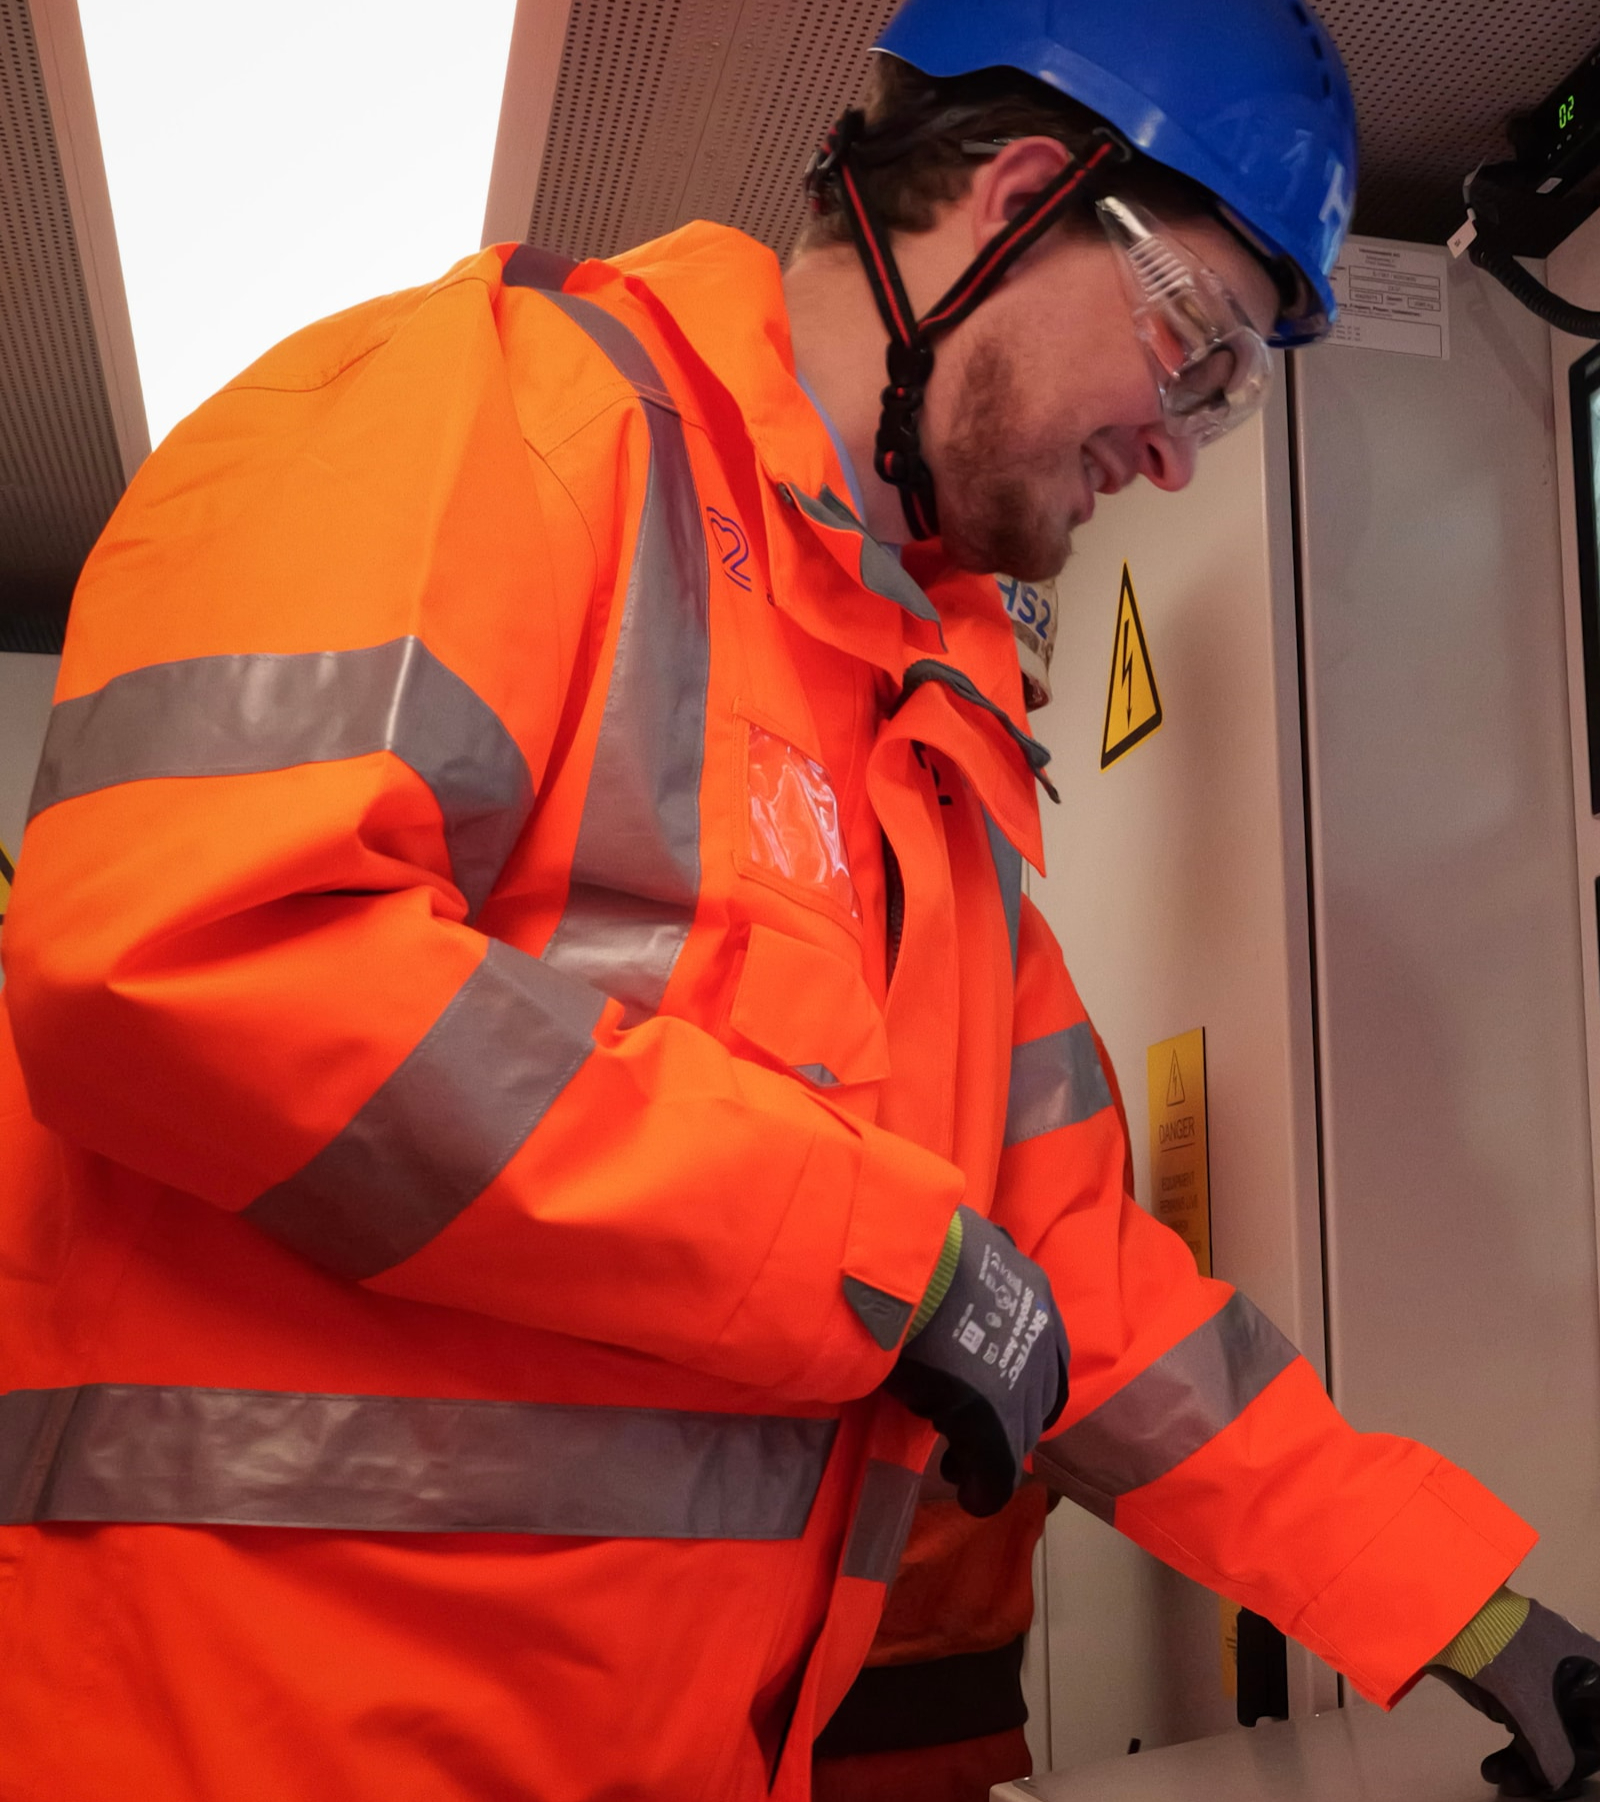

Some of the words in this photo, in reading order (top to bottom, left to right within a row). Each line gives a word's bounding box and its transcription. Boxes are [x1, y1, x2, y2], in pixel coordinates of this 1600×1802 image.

[1559, 95, 1575, 129] 02
[1158, 1116, 1195, 1145] DANGER
[1009, 1309, 1049, 1386] SKYTEC
